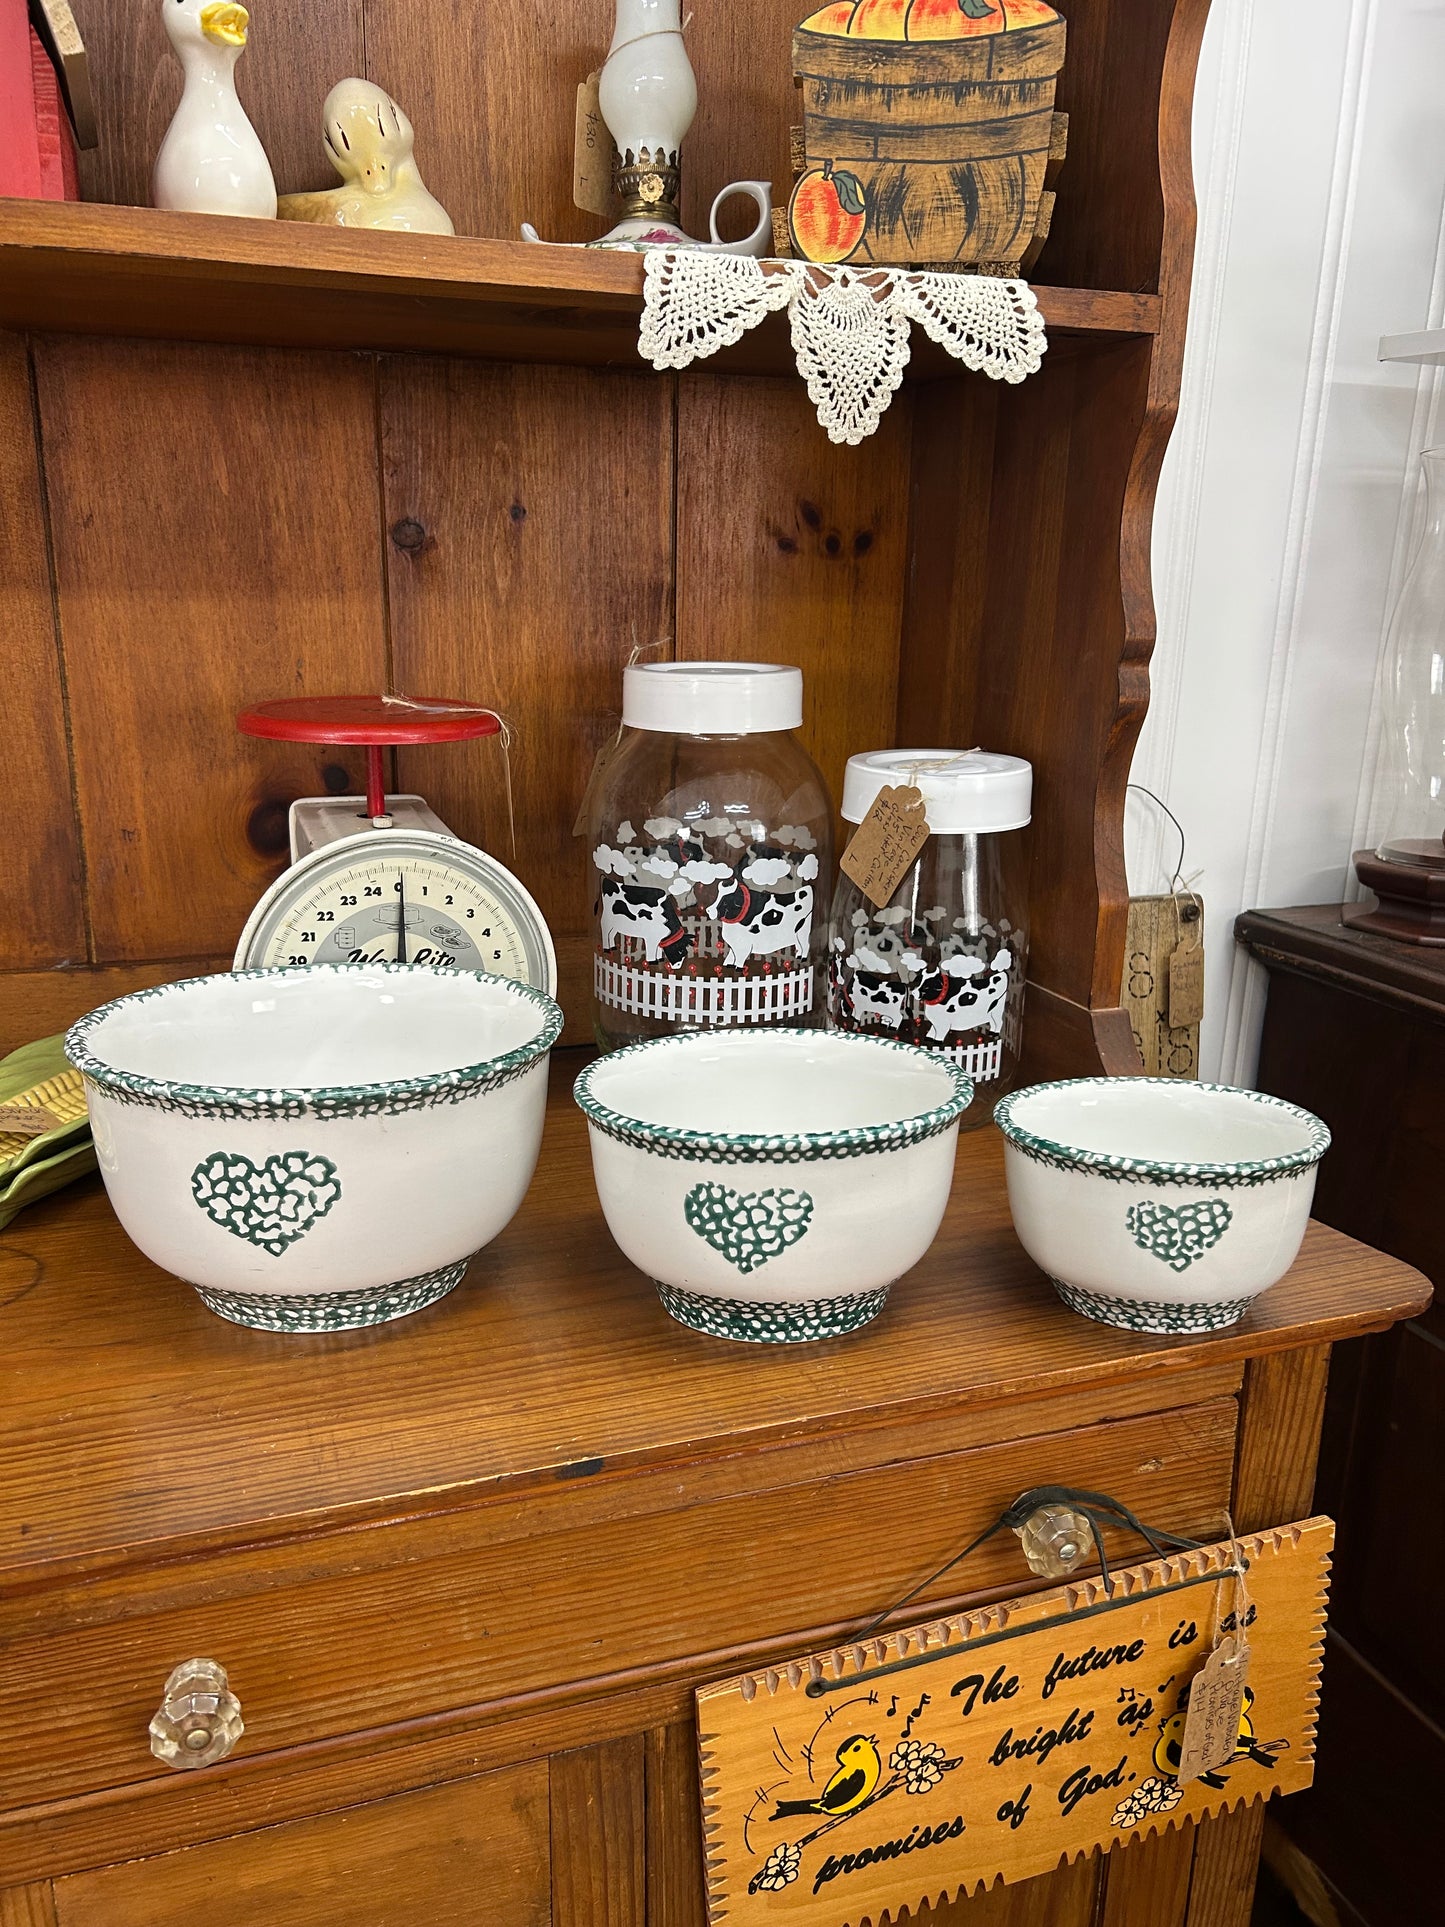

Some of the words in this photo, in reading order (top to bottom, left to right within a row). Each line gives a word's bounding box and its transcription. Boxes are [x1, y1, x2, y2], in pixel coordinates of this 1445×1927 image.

[910, 824, 927, 847] Cow
[883, 825, 912, 867] Vintage
[364, 886, 382, 896] 24
[422, 886, 428, 896] 1
[340, 895, 358, 906] 23
[445, 895, 453, 905] 2
[316, 911, 335, 921] 22
[466, 908, 475, 918] 3
[301, 932, 316, 942] 21
[482, 928, 491, 937] 4
[412, 948, 456, 967] Rite
[493, 950, 501, 959] 5
[288, 955, 308, 966] 20
[950, 1664, 1020, 1716] The
[1041, 1639, 1145, 1700] future
[1168, 1620, 1198, 1649] is
[1220, 1604, 1257, 1633] as
[988, 1707, 1095, 1766] bright
[1117, 1698, 1154, 1726] as
[812, 1816, 966, 1895] promises
[996, 1784, 1032, 1829] of
[1057, 1755, 1137, 1817] God.
